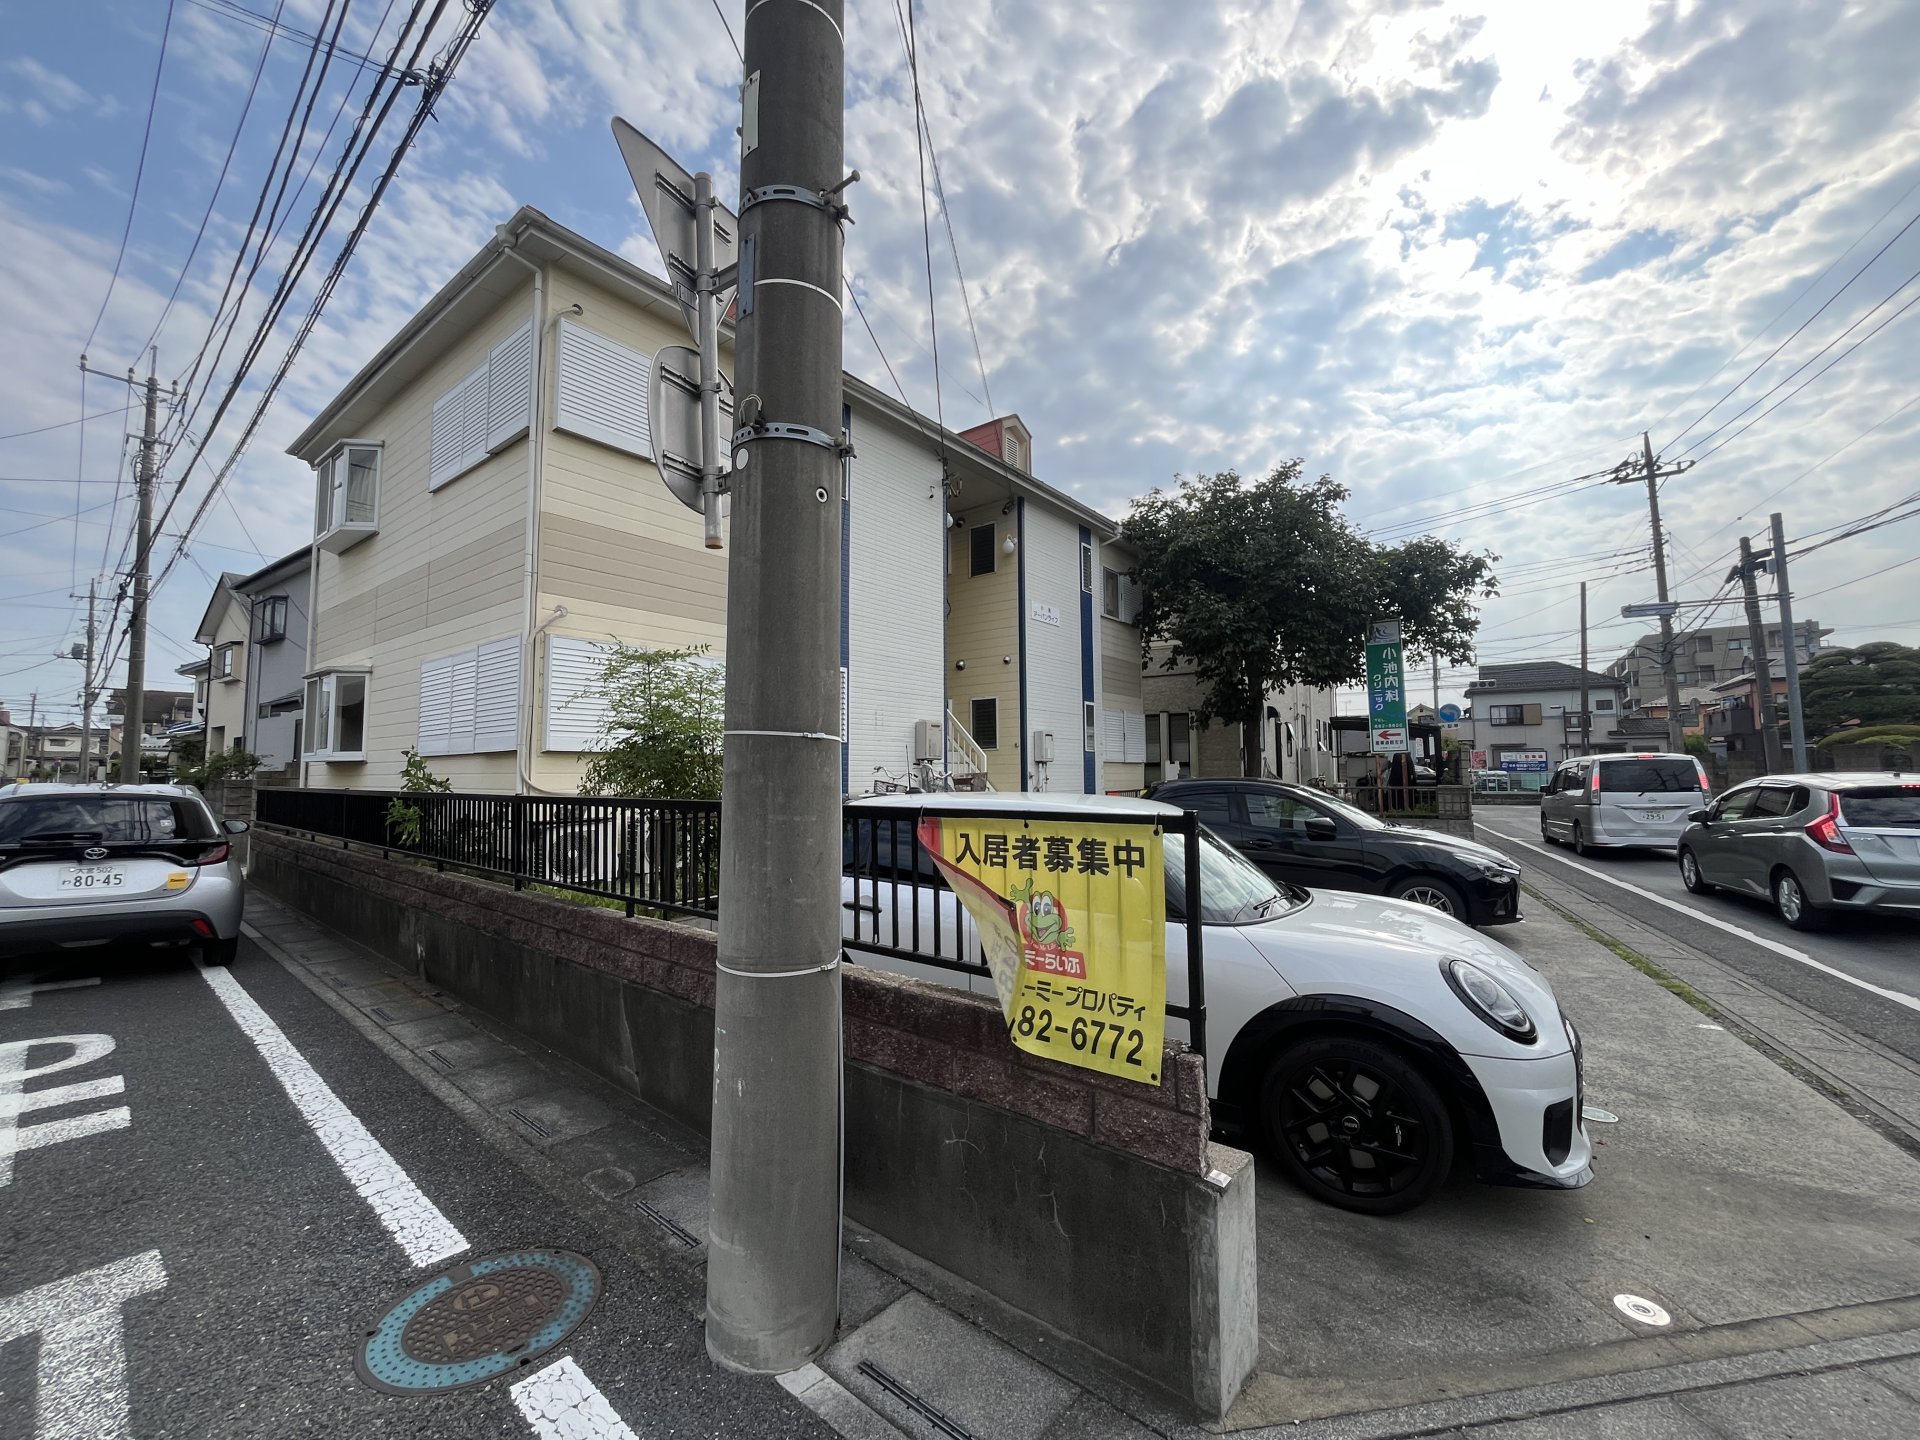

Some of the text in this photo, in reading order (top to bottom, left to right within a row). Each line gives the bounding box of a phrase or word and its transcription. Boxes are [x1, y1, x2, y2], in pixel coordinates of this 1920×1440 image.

[1373, 674, 1384, 711] クリニック
[1382, 647, 1399, 703] 小池内科
[96, 866, 114, 874] 502
[955, 832, 1146, 879] 入居者募集中
[73, 873, 123, 887] 80-45
[1021, 979, 1146, 1021] ーミープロパティ
[1012, 1005, 1144, 1067] 82-6772
